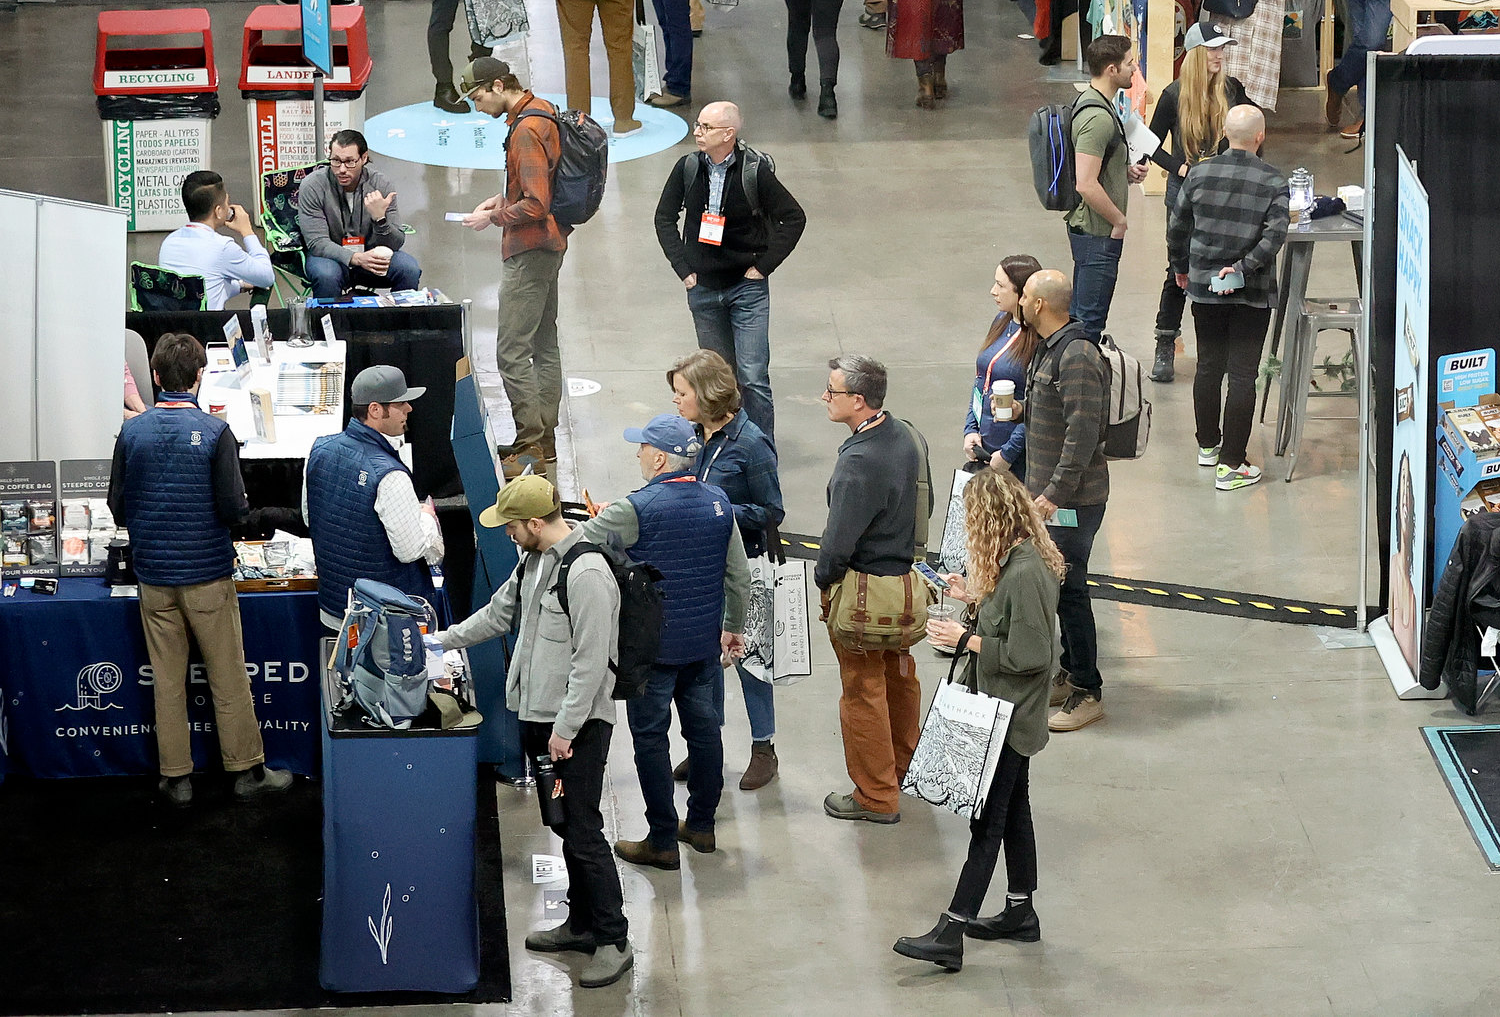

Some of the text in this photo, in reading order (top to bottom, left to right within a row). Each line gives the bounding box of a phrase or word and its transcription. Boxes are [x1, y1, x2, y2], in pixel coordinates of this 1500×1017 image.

[119, 73, 195, 84] RECYCLING
[136, 130, 157, 138] PAPER
[178, 128, 199, 137] TYPES
[136, 138, 199, 148] (TODOS PAPELES)
[136, 149, 171, 157] CARDBOARD
[137, 176, 170, 187] METAL
[137, 188, 161, 197] (LATAS
[163, 188, 172, 196] DE
[137, 199, 179, 209] PLASTICS
[1450, 355, 1486, 371] BUILT
[789, 588, 799, 663] EARTHPACK
